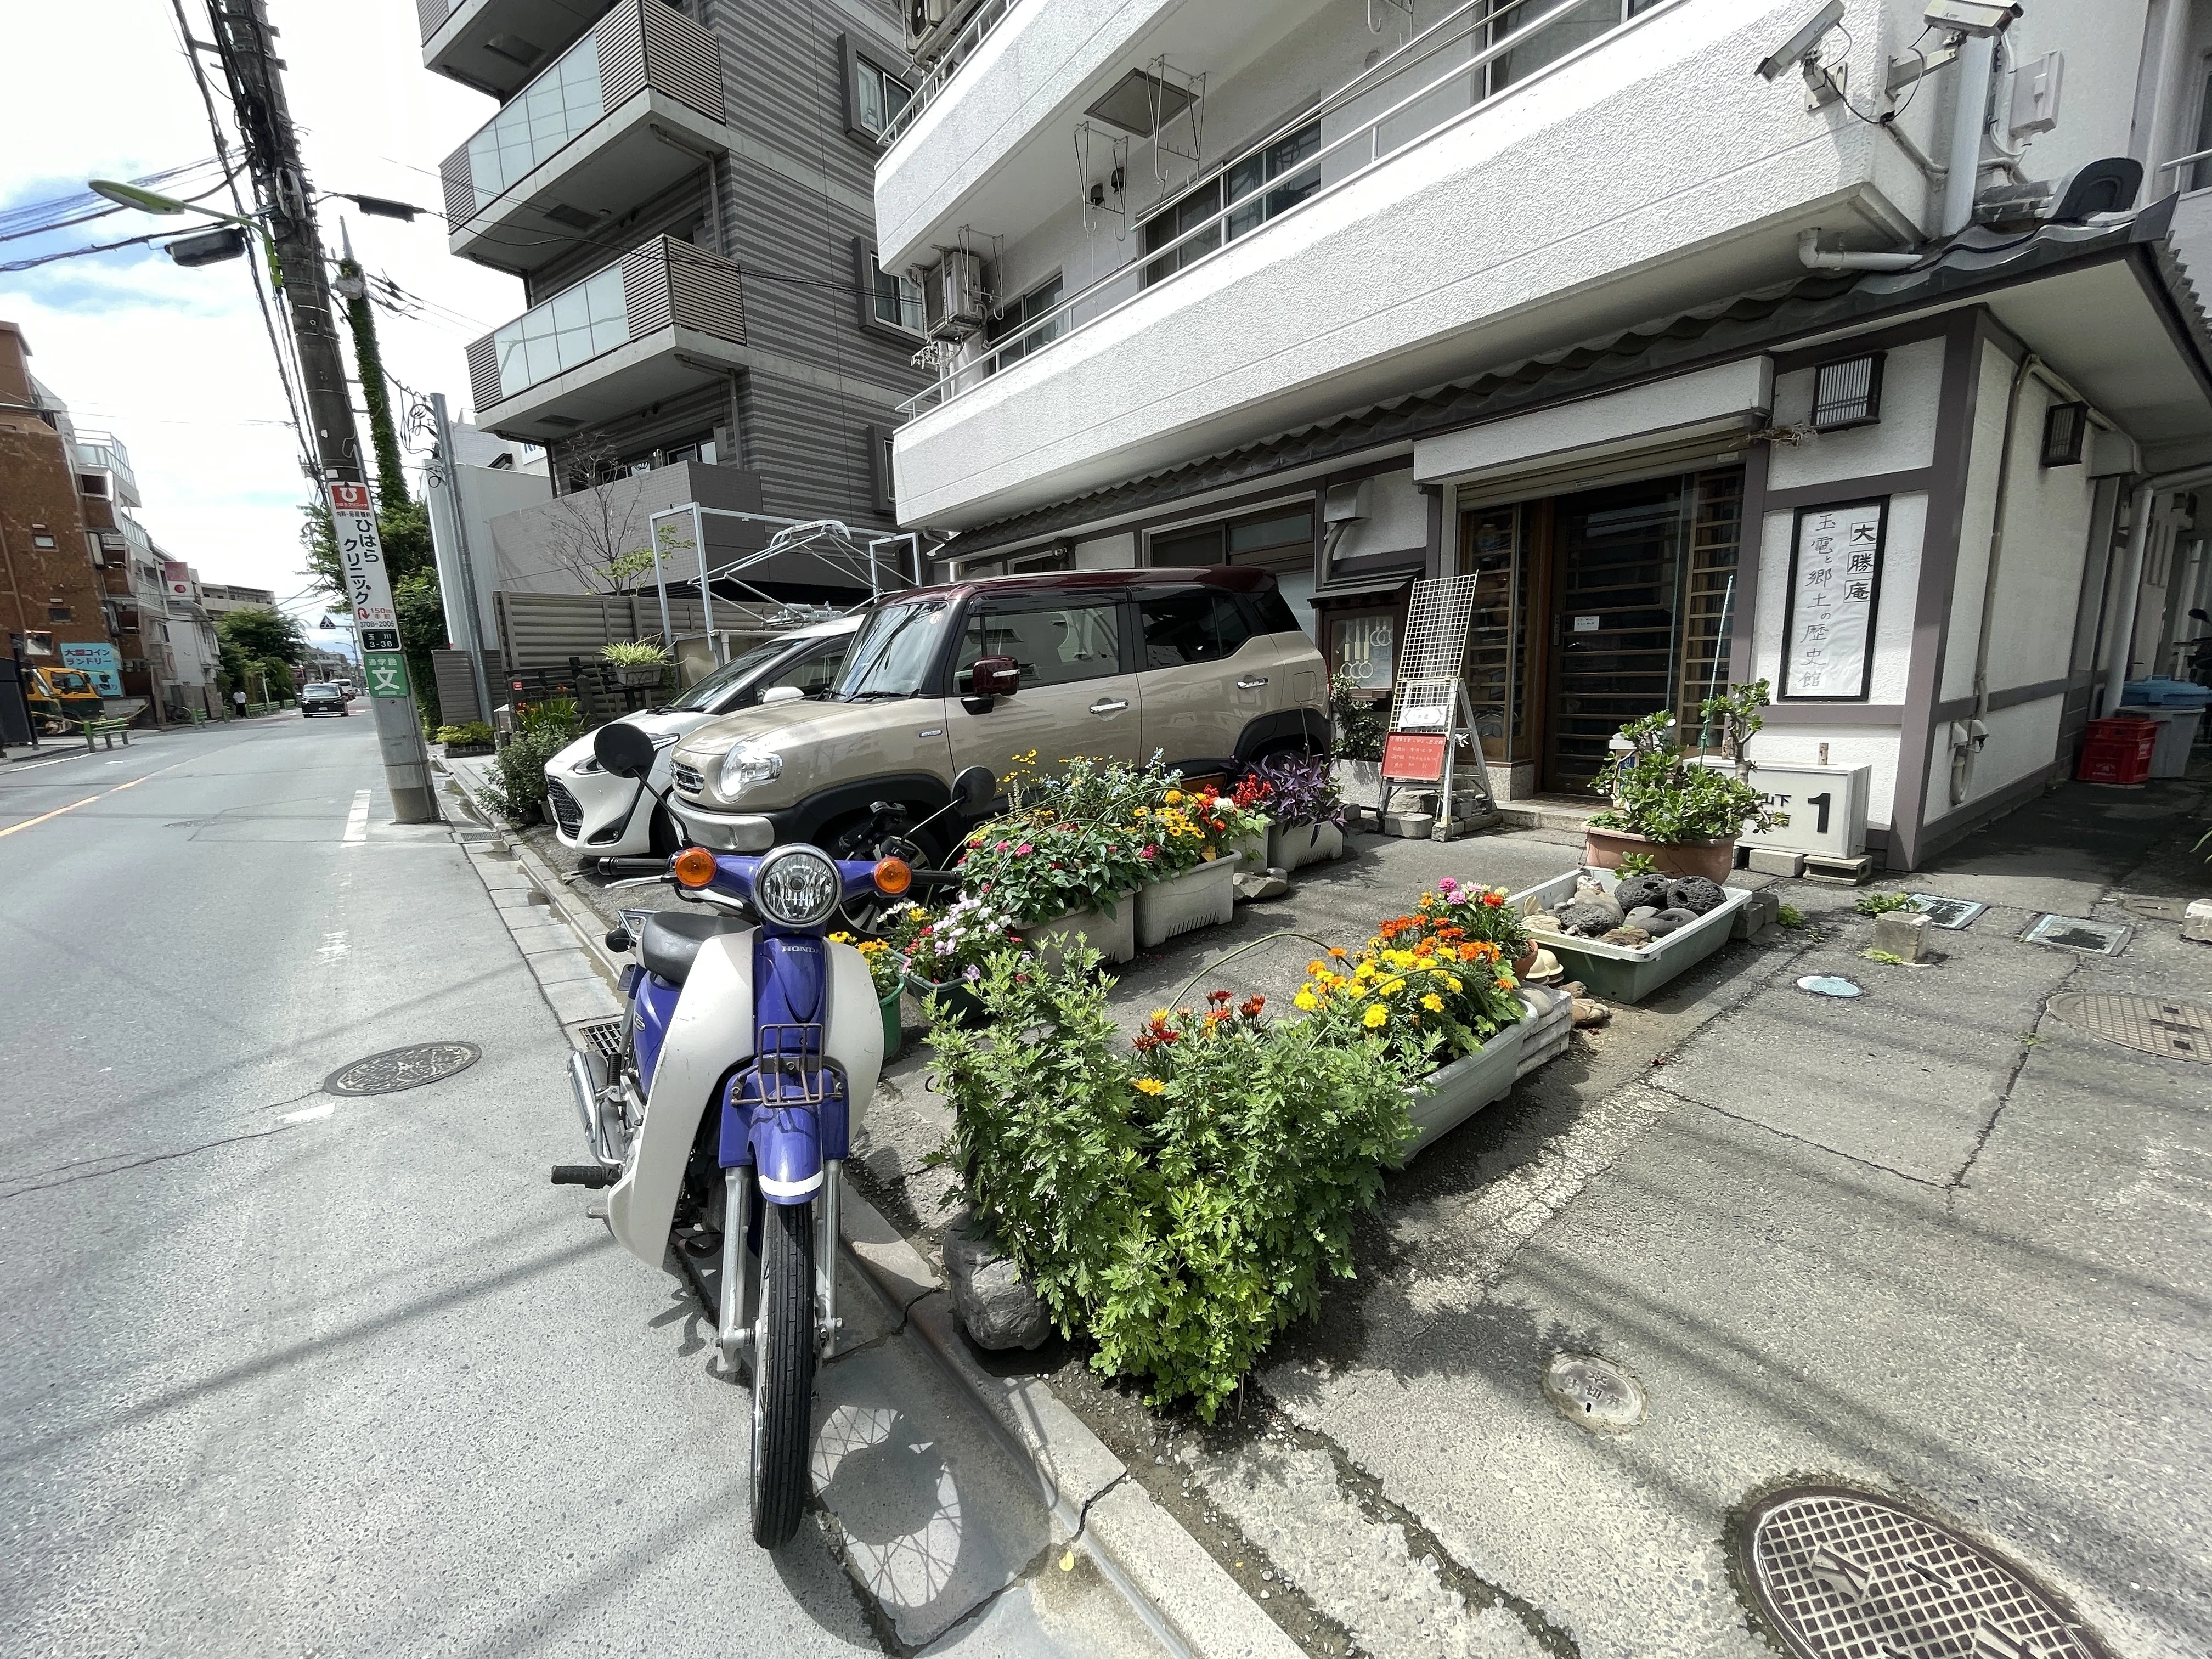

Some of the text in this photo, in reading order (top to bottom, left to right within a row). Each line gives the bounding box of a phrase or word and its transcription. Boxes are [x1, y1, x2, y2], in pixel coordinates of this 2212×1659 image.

[355, 519, 379, 563] ひはら
[1844, 524, 1876, 601] 大勝庵
[344, 538, 369, 605] クリニック
[1798, 514, 1836, 688] 玉電と郷土の歴史館
[371, 667, 400, 691] 文
[1807, 792, 1831, 833] 1
